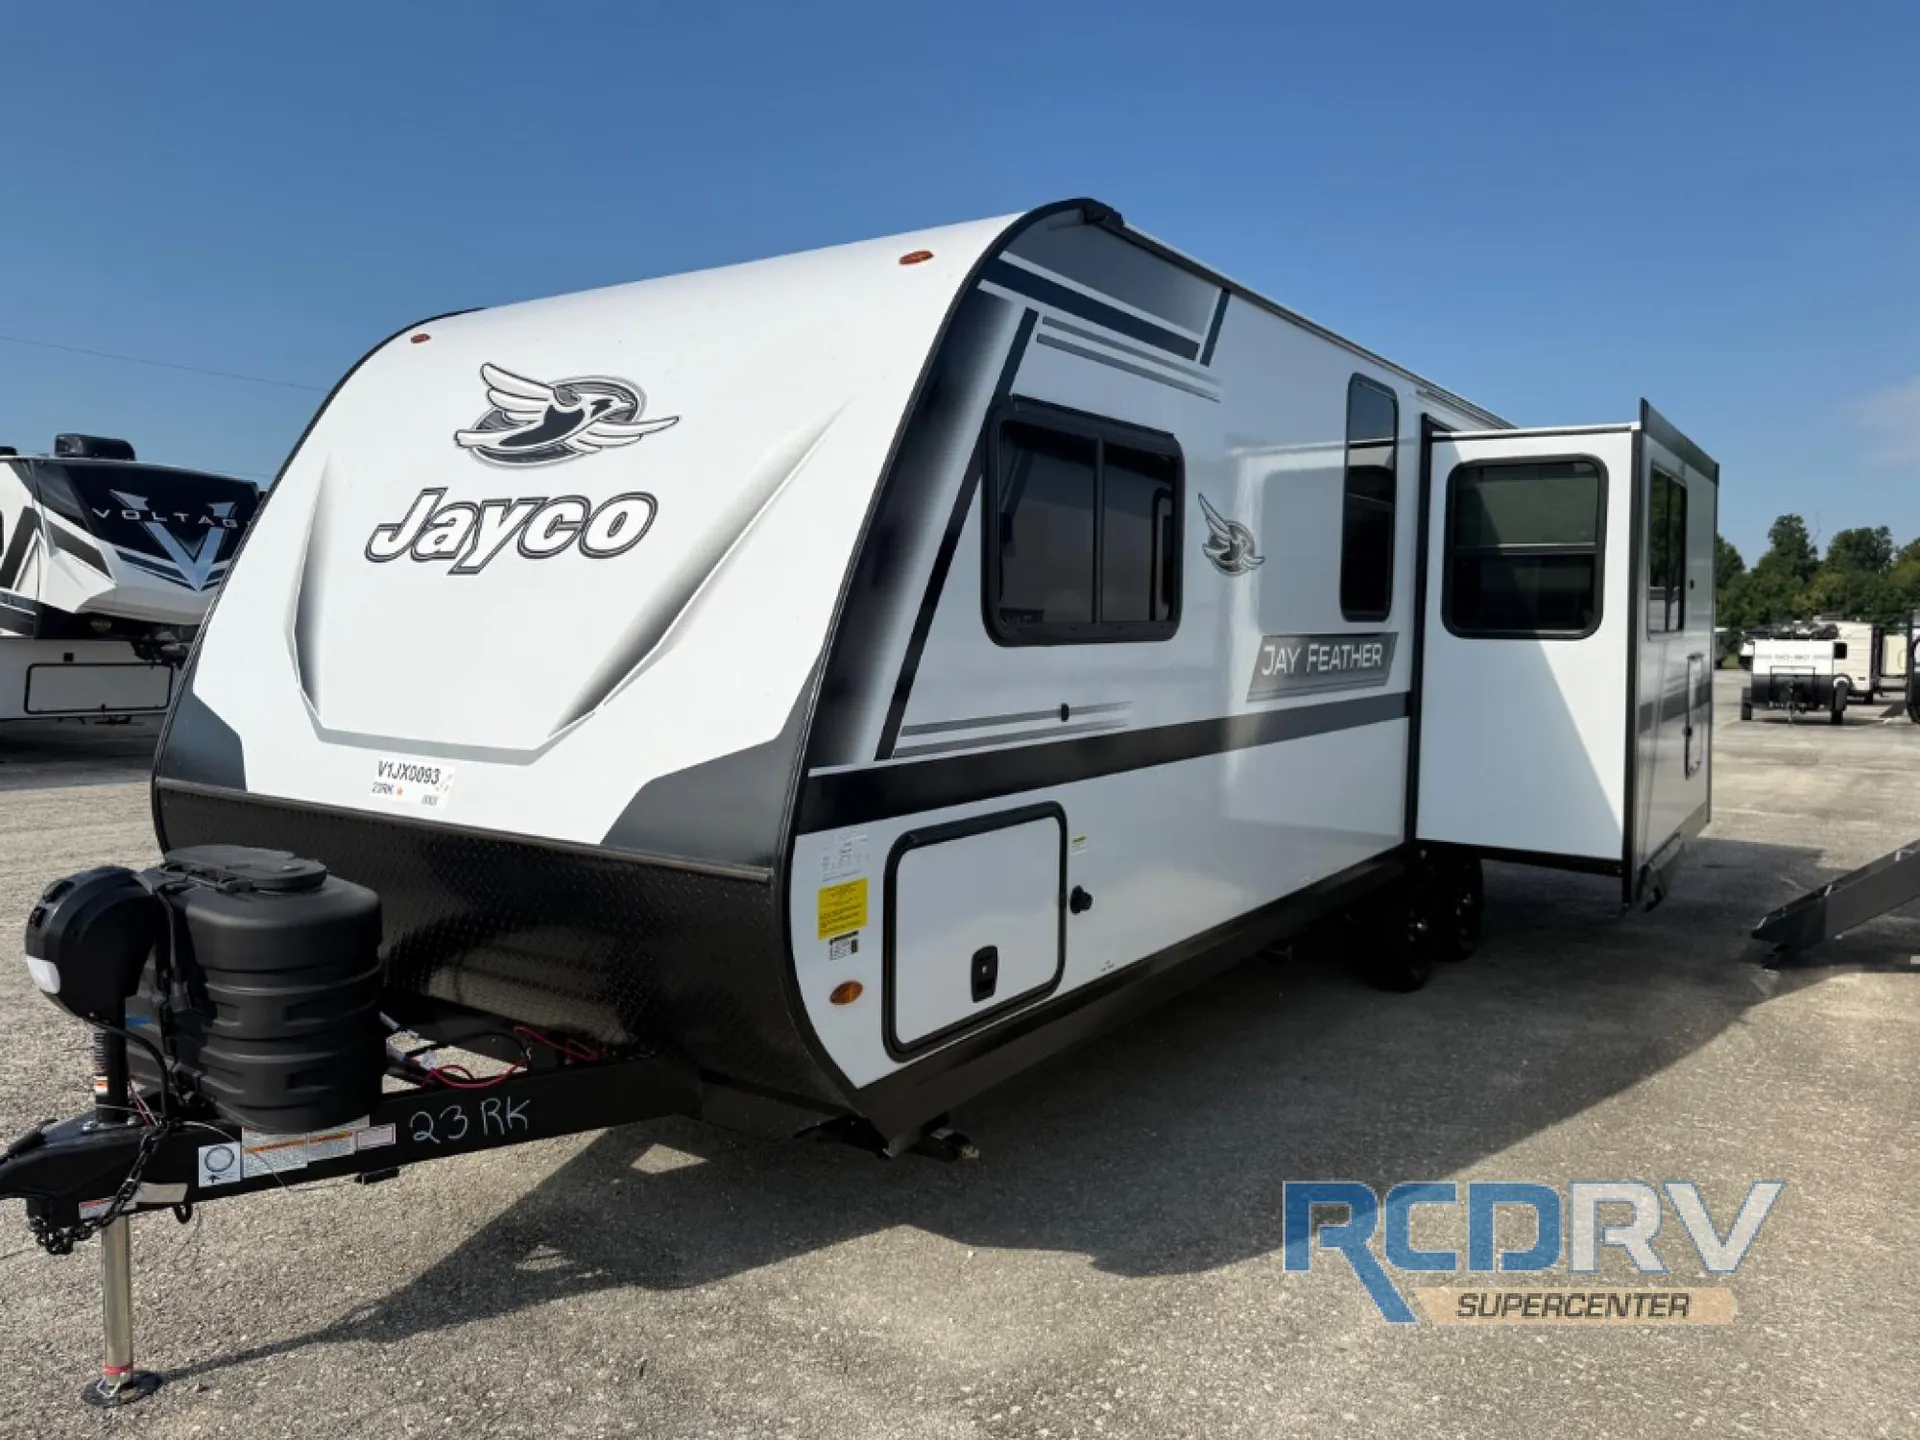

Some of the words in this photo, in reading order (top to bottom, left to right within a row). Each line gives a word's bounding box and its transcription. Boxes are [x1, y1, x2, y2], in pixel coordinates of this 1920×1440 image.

[91, 507, 252, 530] VOLTAG
[364, 486, 659, 575] Jayco
[1261, 644, 1300, 676] JAY
[1306, 643, 1383, 673] FEATHER
[378, 759, 441, 785] V1JX0093
[409, 1104, 469, 1144] 23
